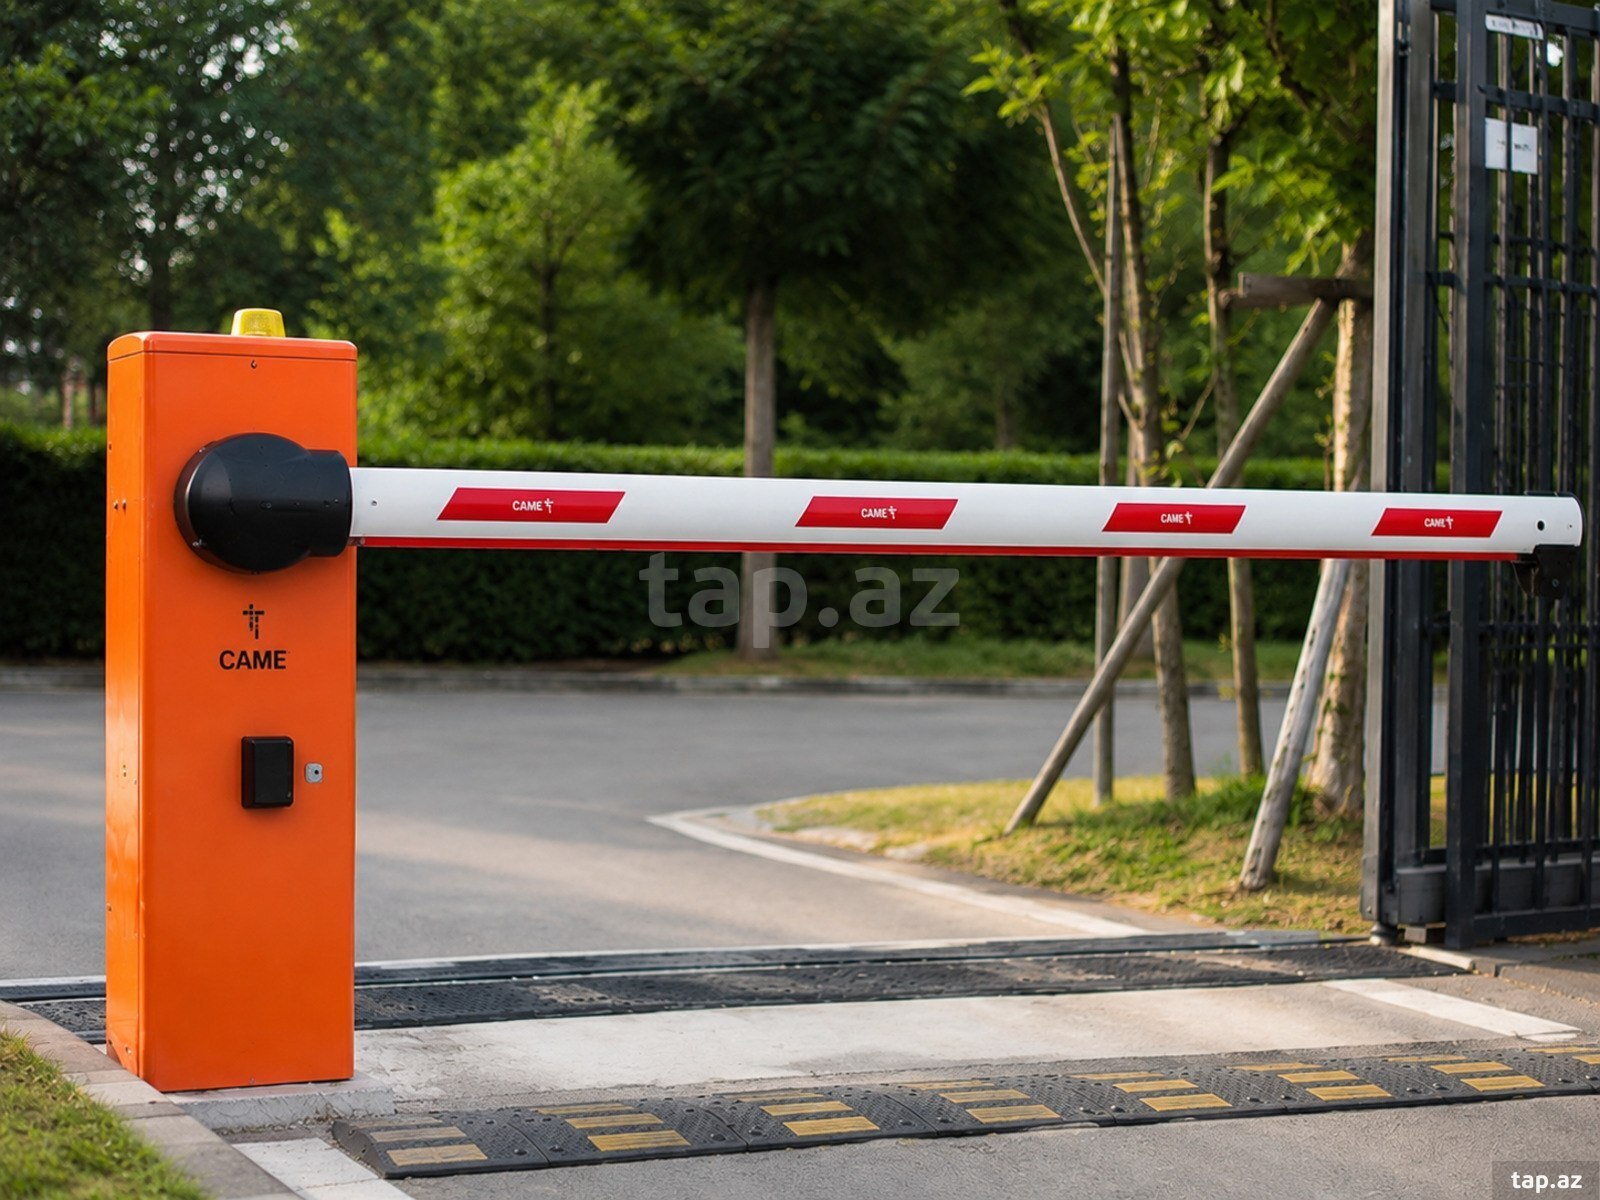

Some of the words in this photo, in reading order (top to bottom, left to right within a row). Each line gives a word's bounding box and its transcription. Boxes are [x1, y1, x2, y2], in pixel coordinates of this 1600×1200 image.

[512, 500, 543, 511] CAME
[861, 508, 888, 518] CAME
[1160, 513, 1184, 524] CAME
[219, 650, 287, 670] CAME
